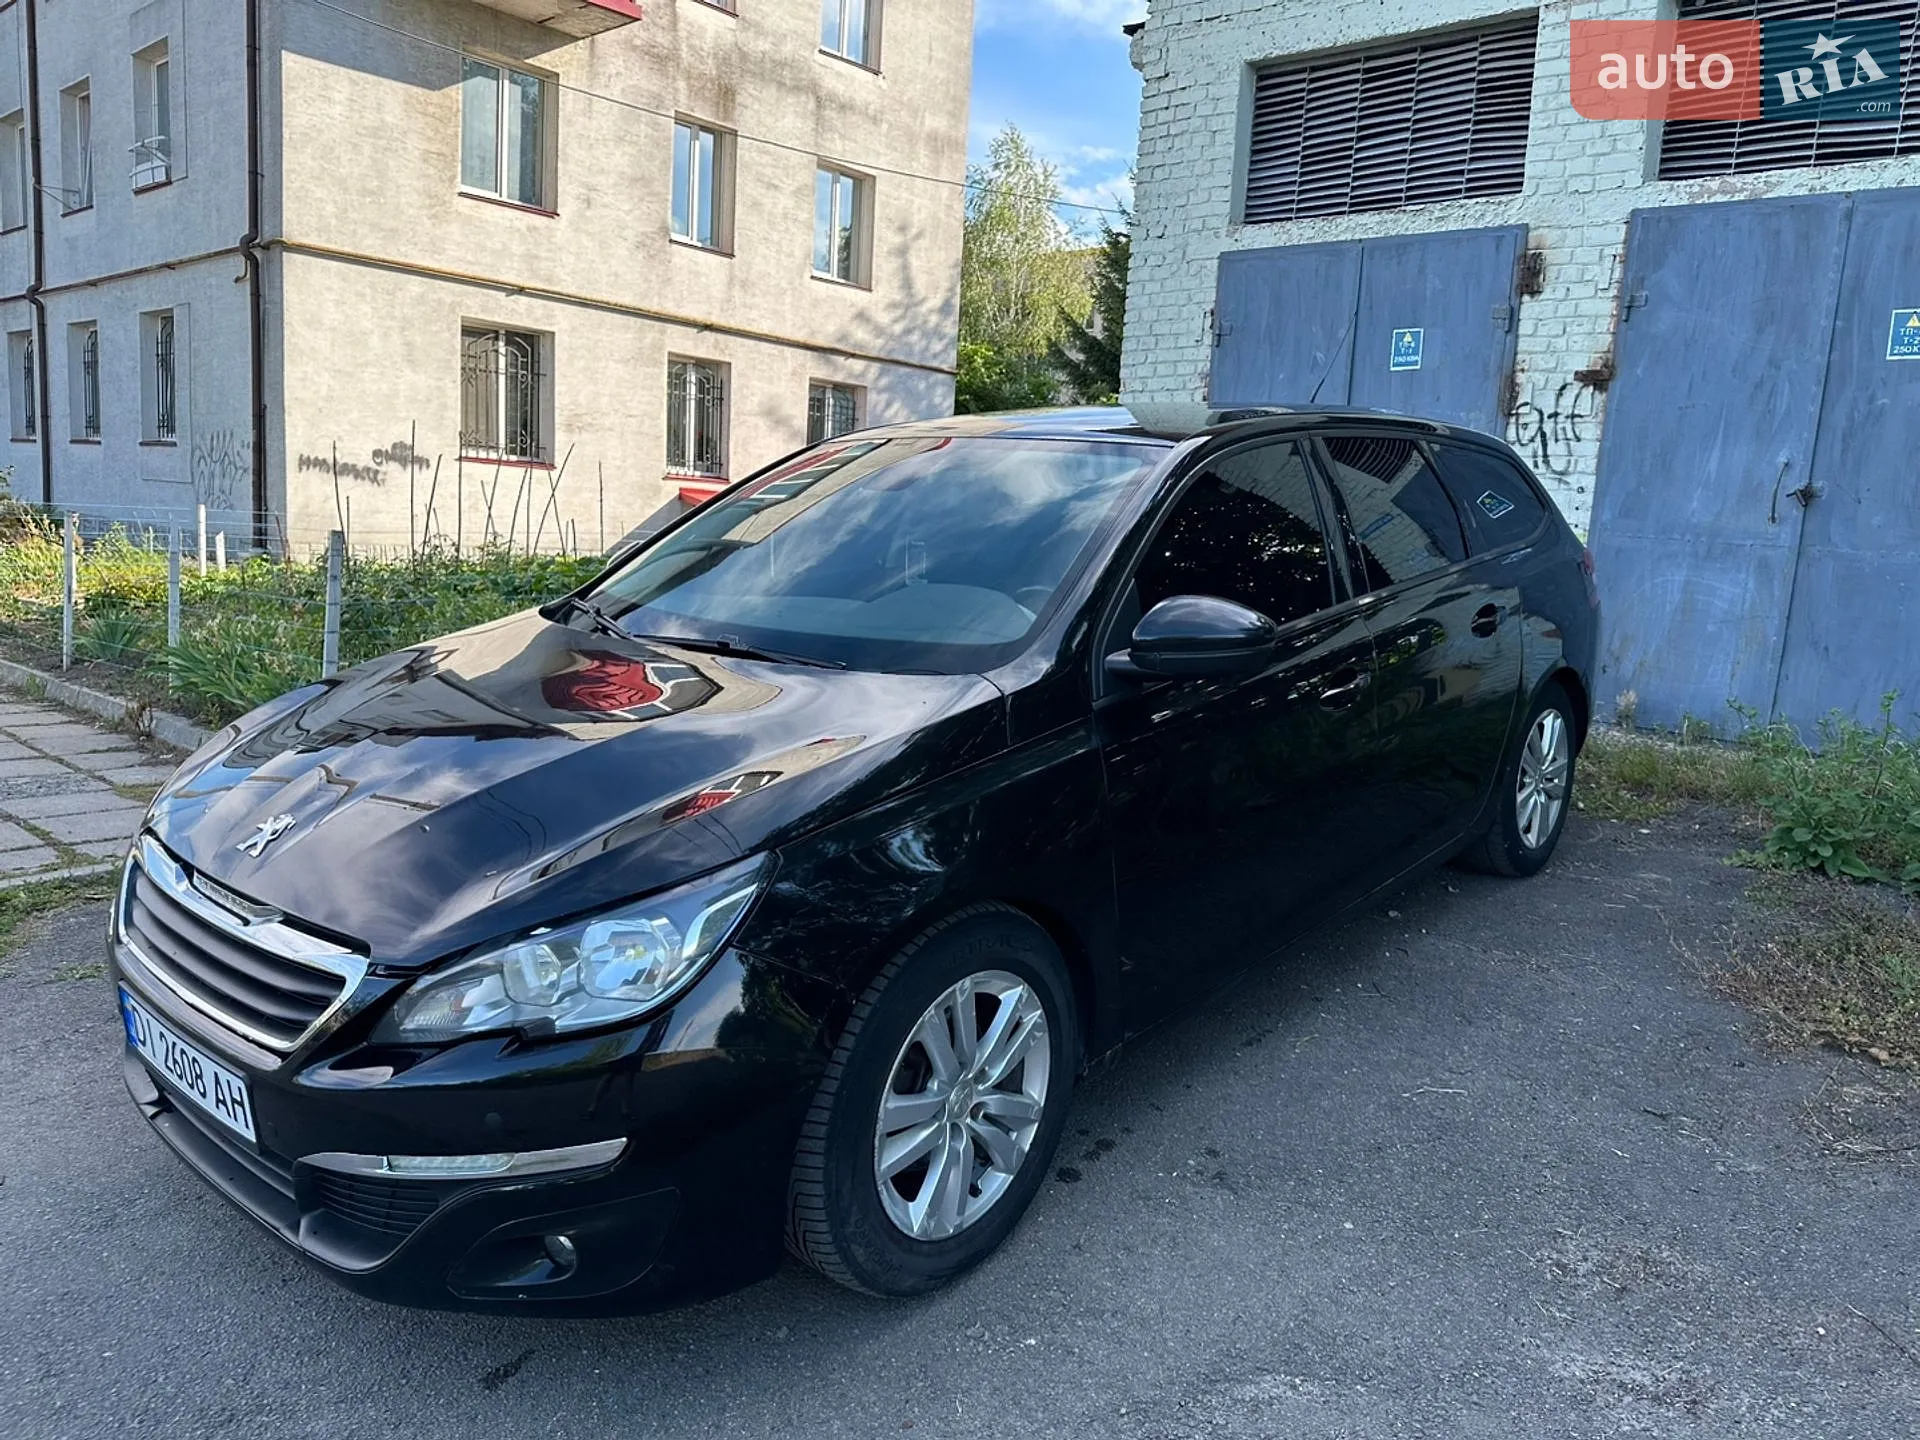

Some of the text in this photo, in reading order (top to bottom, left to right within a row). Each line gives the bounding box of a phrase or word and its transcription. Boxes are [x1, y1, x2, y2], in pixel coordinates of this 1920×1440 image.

[132, 1004, 250, 1129] DI 2608 AH
